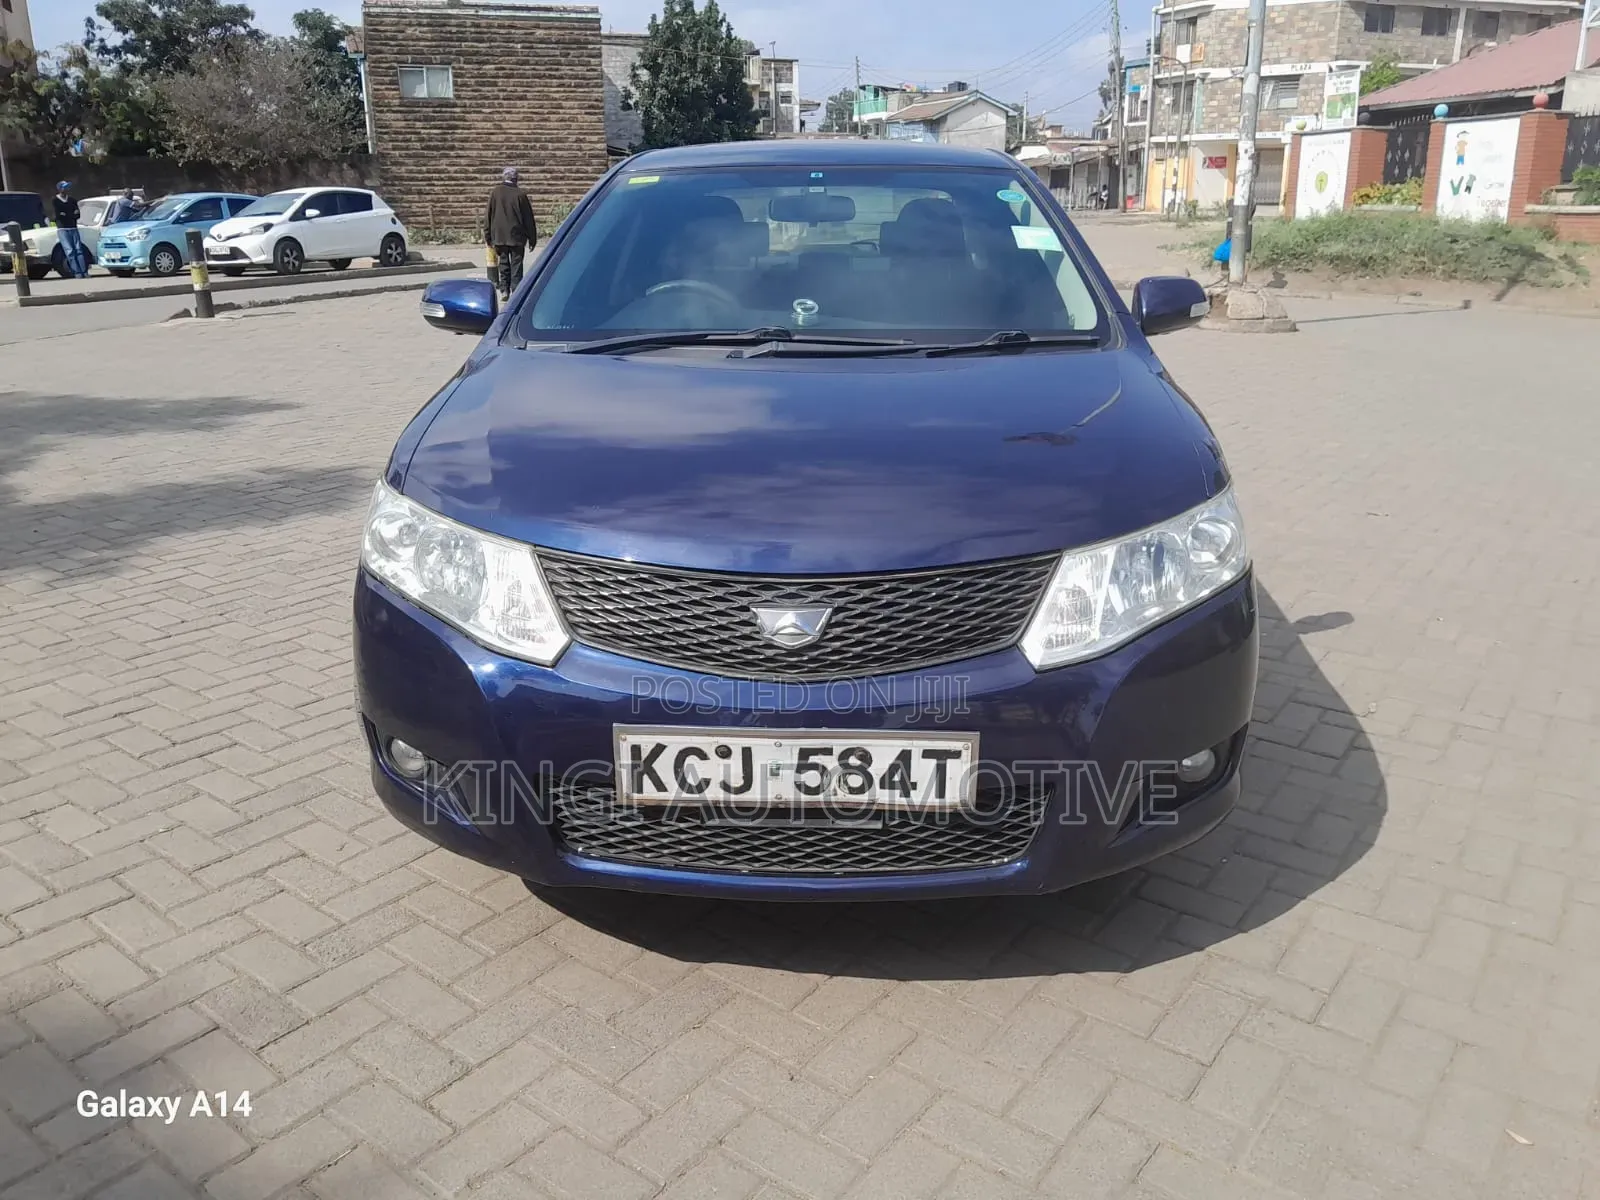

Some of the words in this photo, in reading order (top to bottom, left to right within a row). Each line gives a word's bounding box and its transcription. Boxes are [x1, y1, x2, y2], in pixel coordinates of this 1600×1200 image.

[1290, 63, 1312, 72] PLAZA
[629, 742, 754, 796] KCJ
[793, 746, 962, 798] 584T
